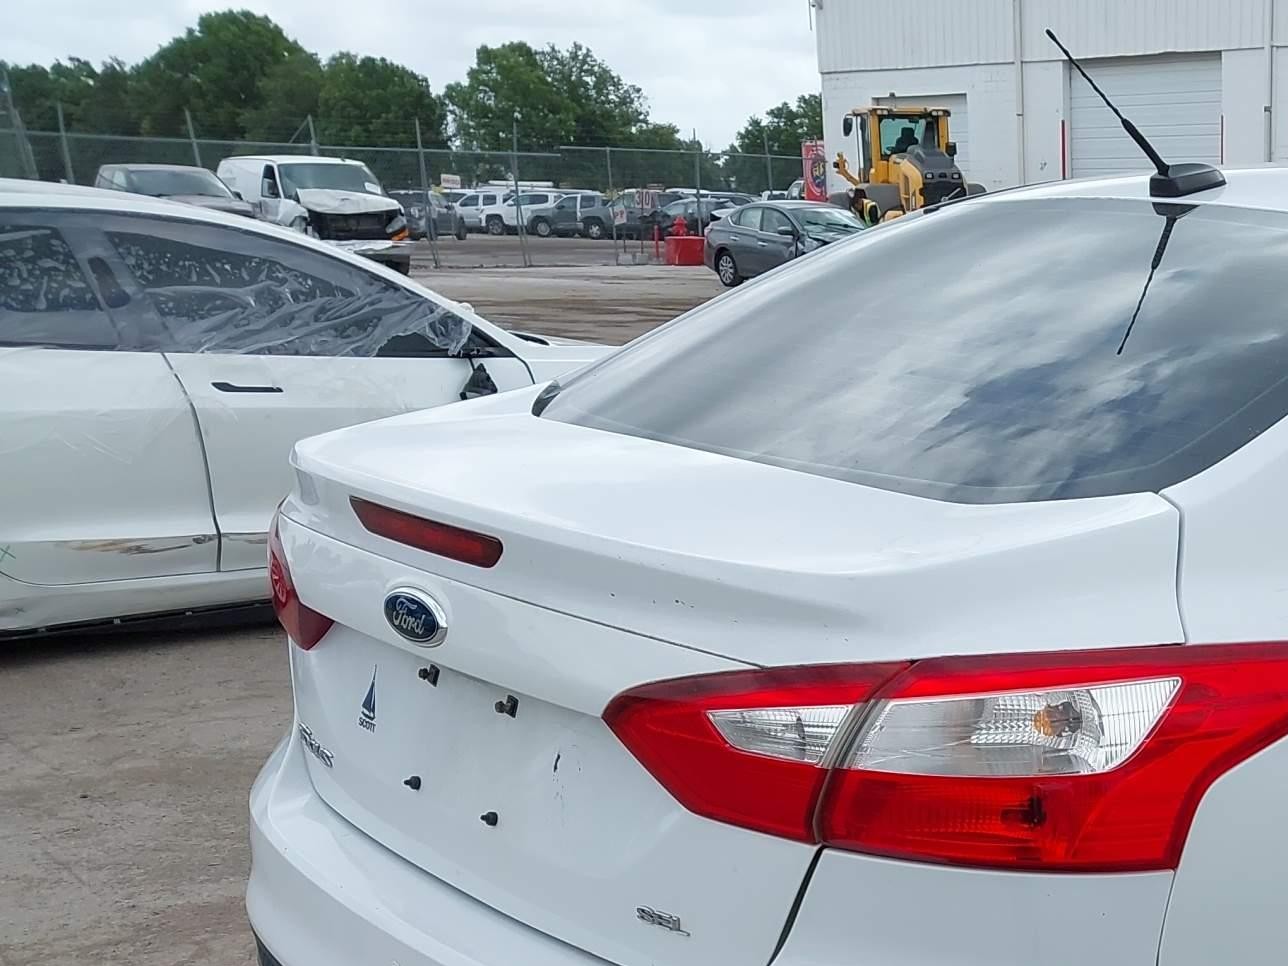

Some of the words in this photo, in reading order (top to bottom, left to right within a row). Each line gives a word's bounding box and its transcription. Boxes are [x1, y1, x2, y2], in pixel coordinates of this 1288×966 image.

[393, 598, 425, 634] Ford
[358, 717, 376, 733] SCOTT
[637, 905, 690, 937] SEL
